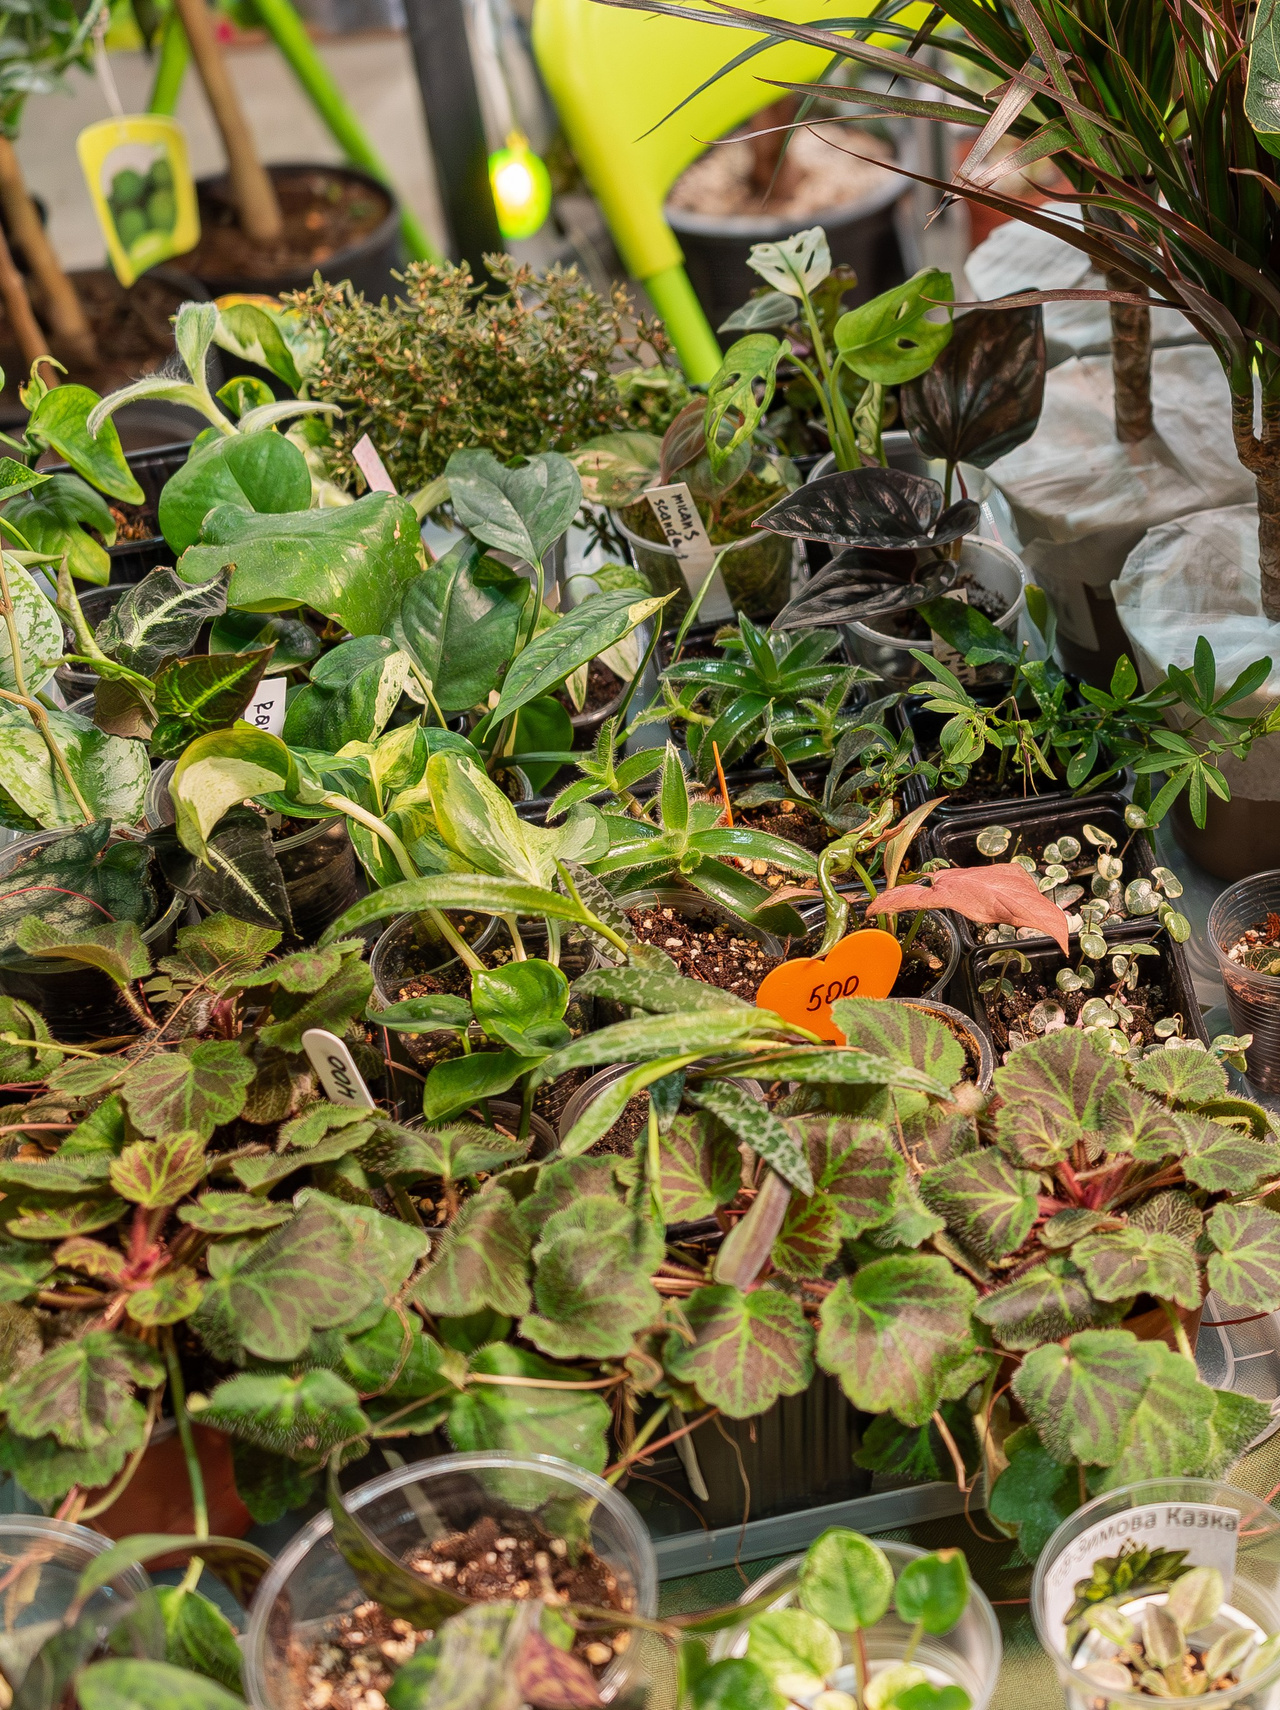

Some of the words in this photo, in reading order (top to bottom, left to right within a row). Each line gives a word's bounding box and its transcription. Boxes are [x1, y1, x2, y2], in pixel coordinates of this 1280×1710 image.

[806, 975, 859, 1012] 500
[327, 1055, 357, 1100] 400
[1165, 1507, 1238, 1533] Казка
